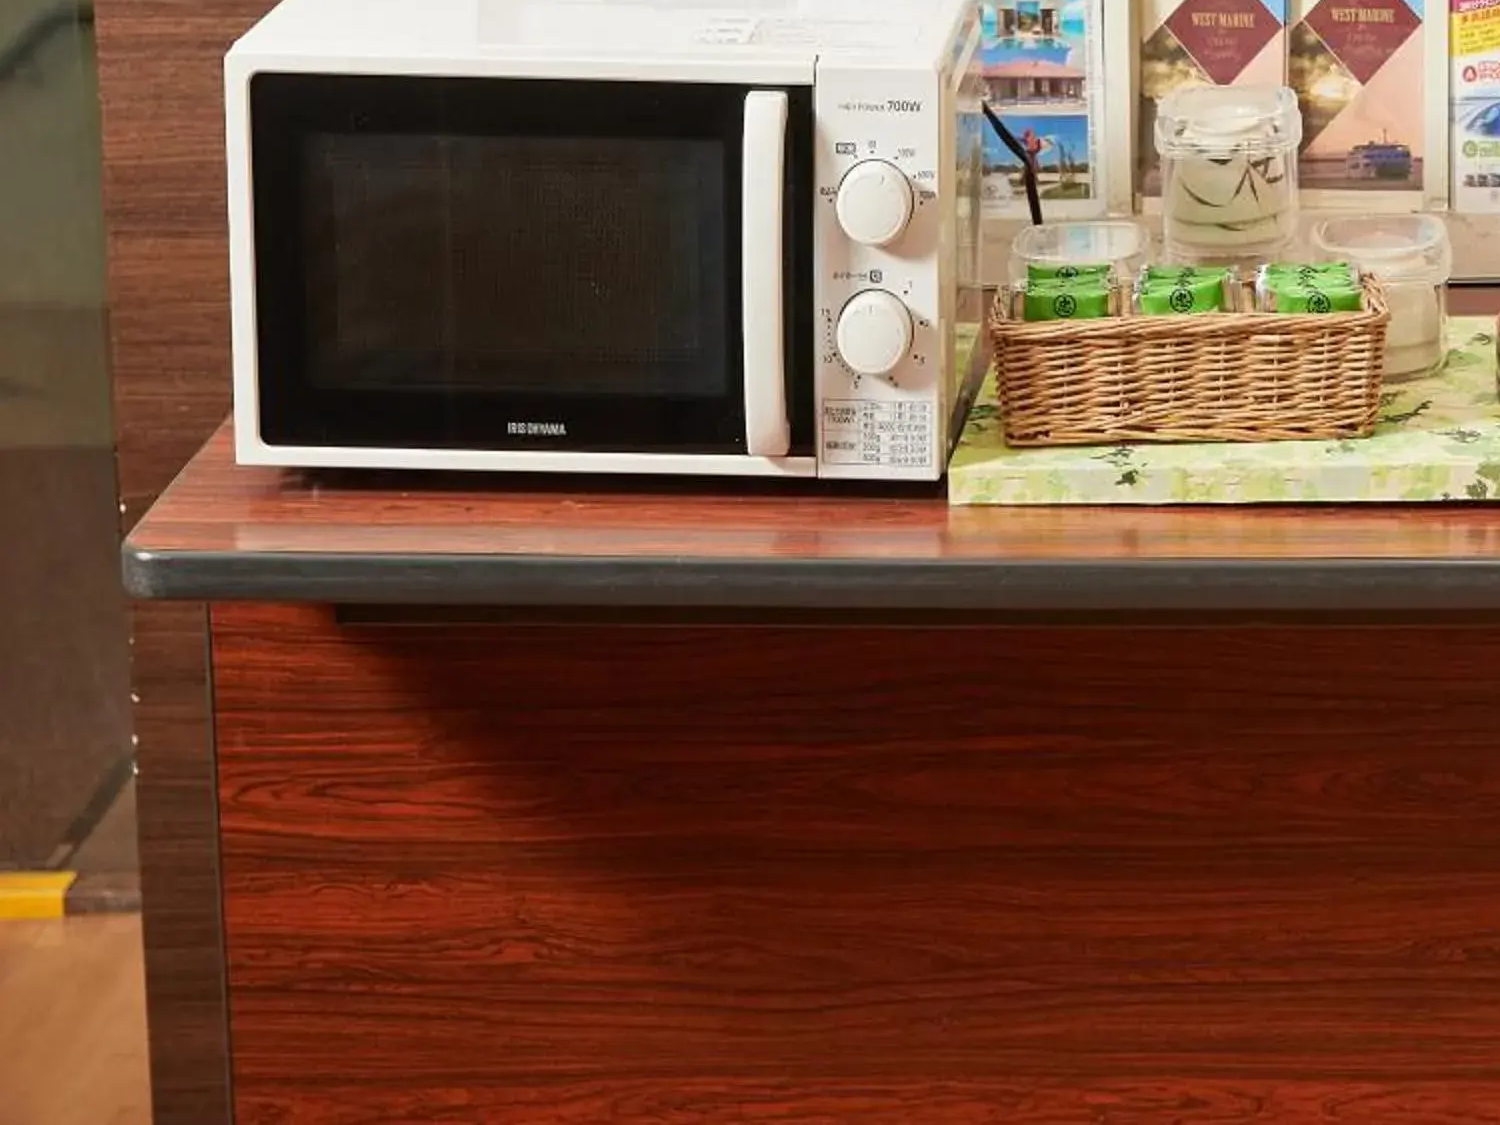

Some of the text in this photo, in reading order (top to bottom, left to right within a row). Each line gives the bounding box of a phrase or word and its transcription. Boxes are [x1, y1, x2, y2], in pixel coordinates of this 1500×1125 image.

[1192, 12, 1217, 27] WEST
[1331, 7, 1357, 22] WEST
[887, 100, 922, 113] 700W
[507, 422, 527, 434] IRIS
